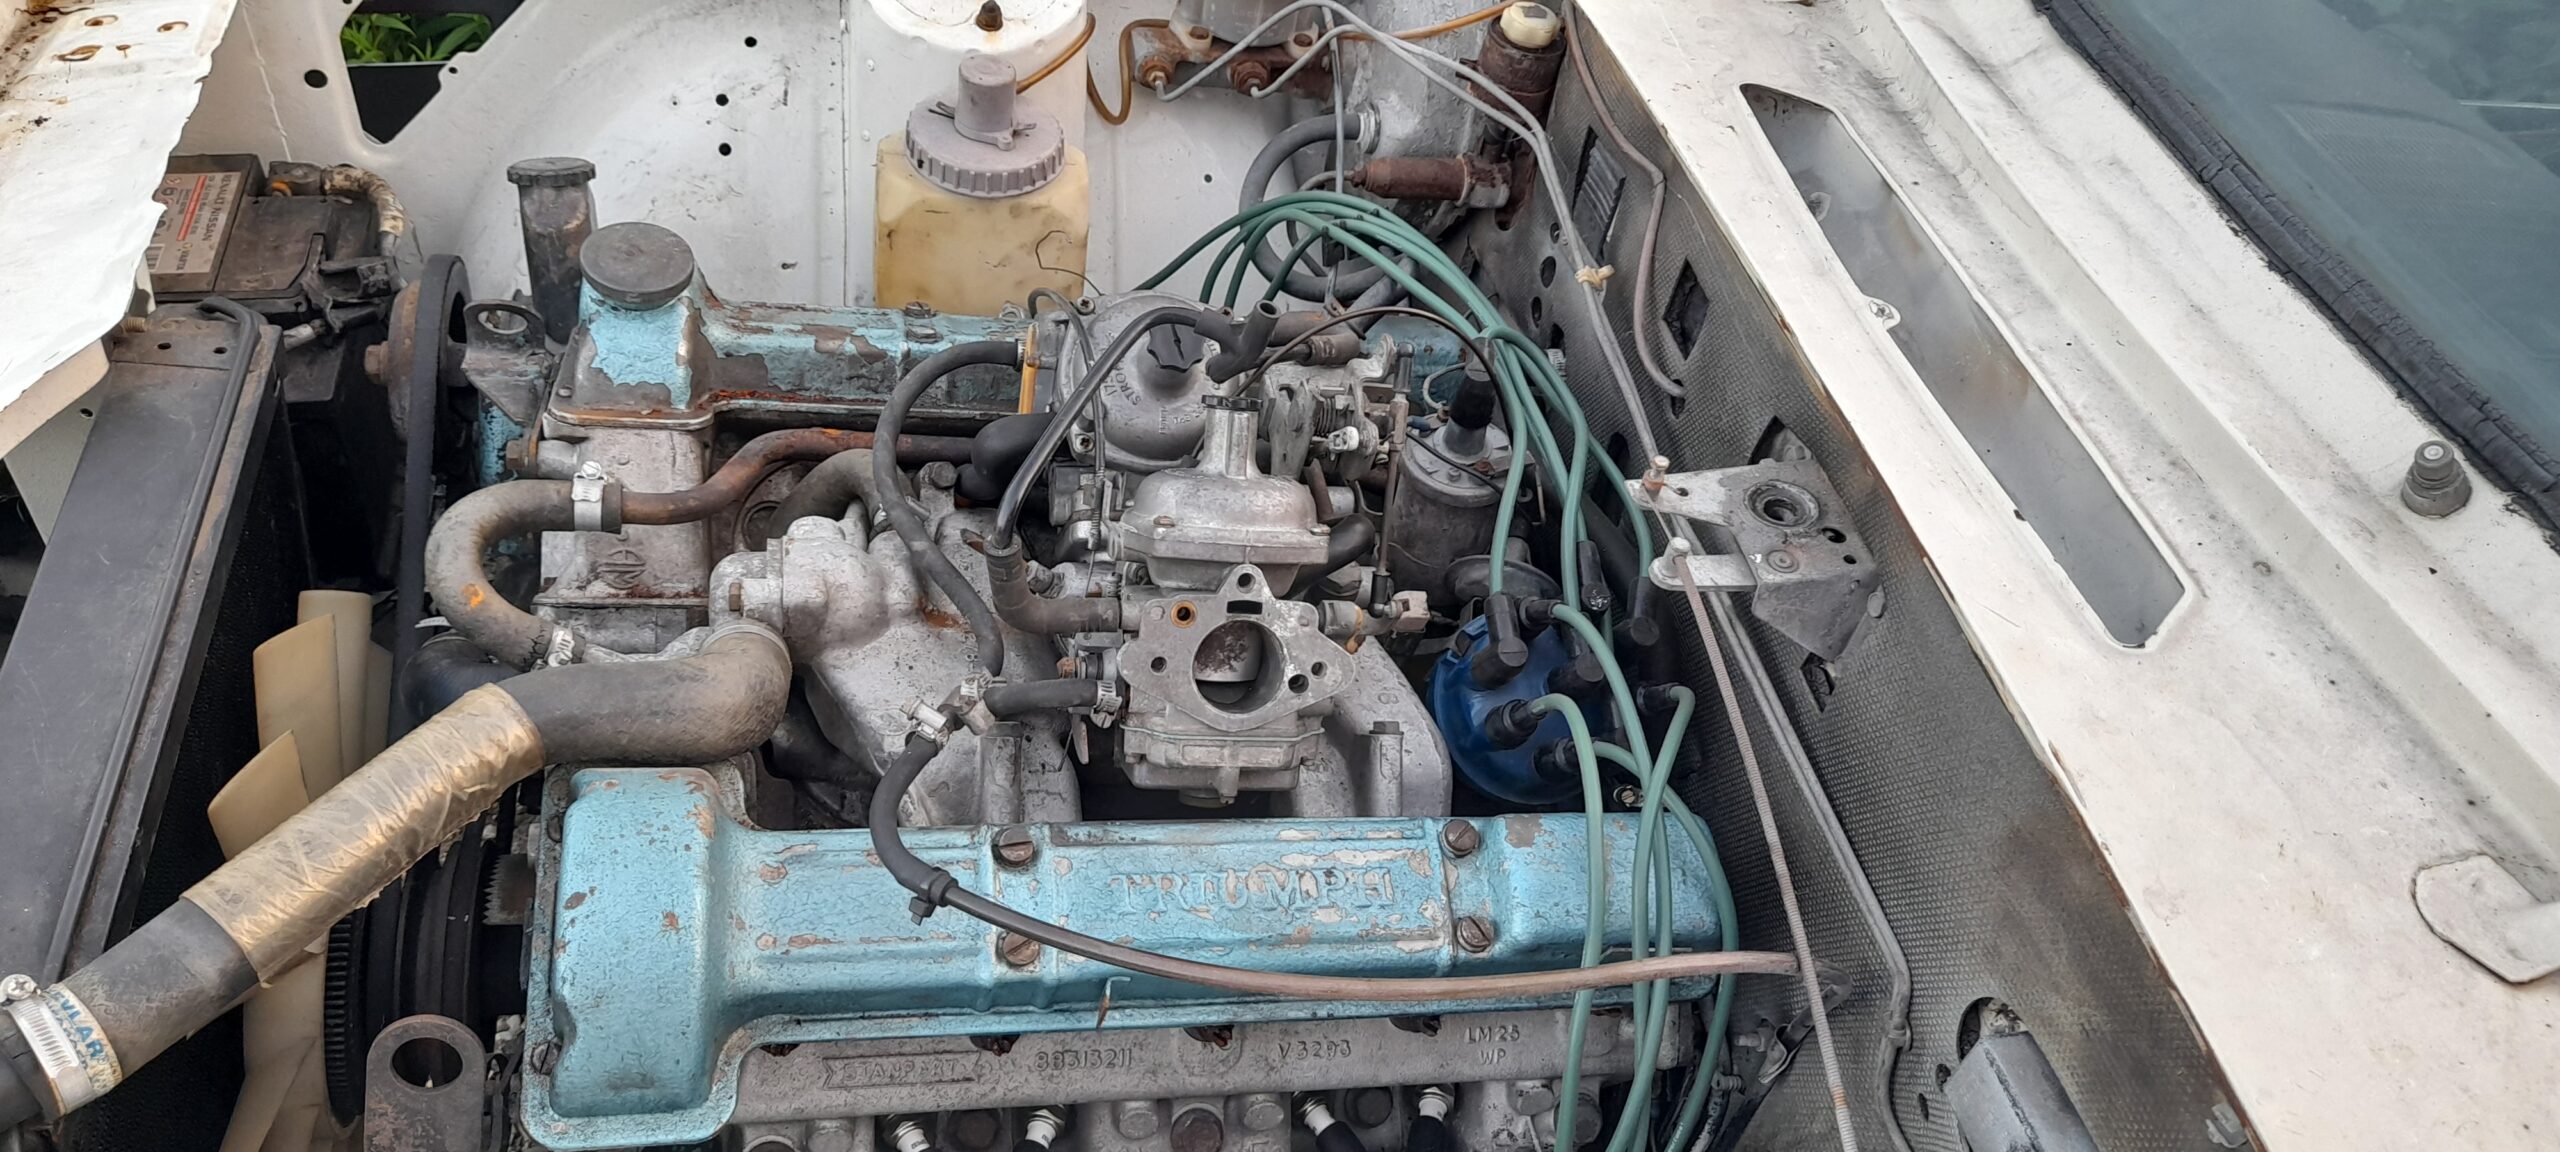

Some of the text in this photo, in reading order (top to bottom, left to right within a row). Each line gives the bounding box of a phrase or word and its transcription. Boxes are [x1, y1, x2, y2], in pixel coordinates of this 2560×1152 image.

[202, 206, 223, 242] NISSAN
[1109, 866, 1398, 916] TRIUMPH
[1034, 1047, 1133, 1072] 88313211
[1479, 1047, 1507, 1066] WP
